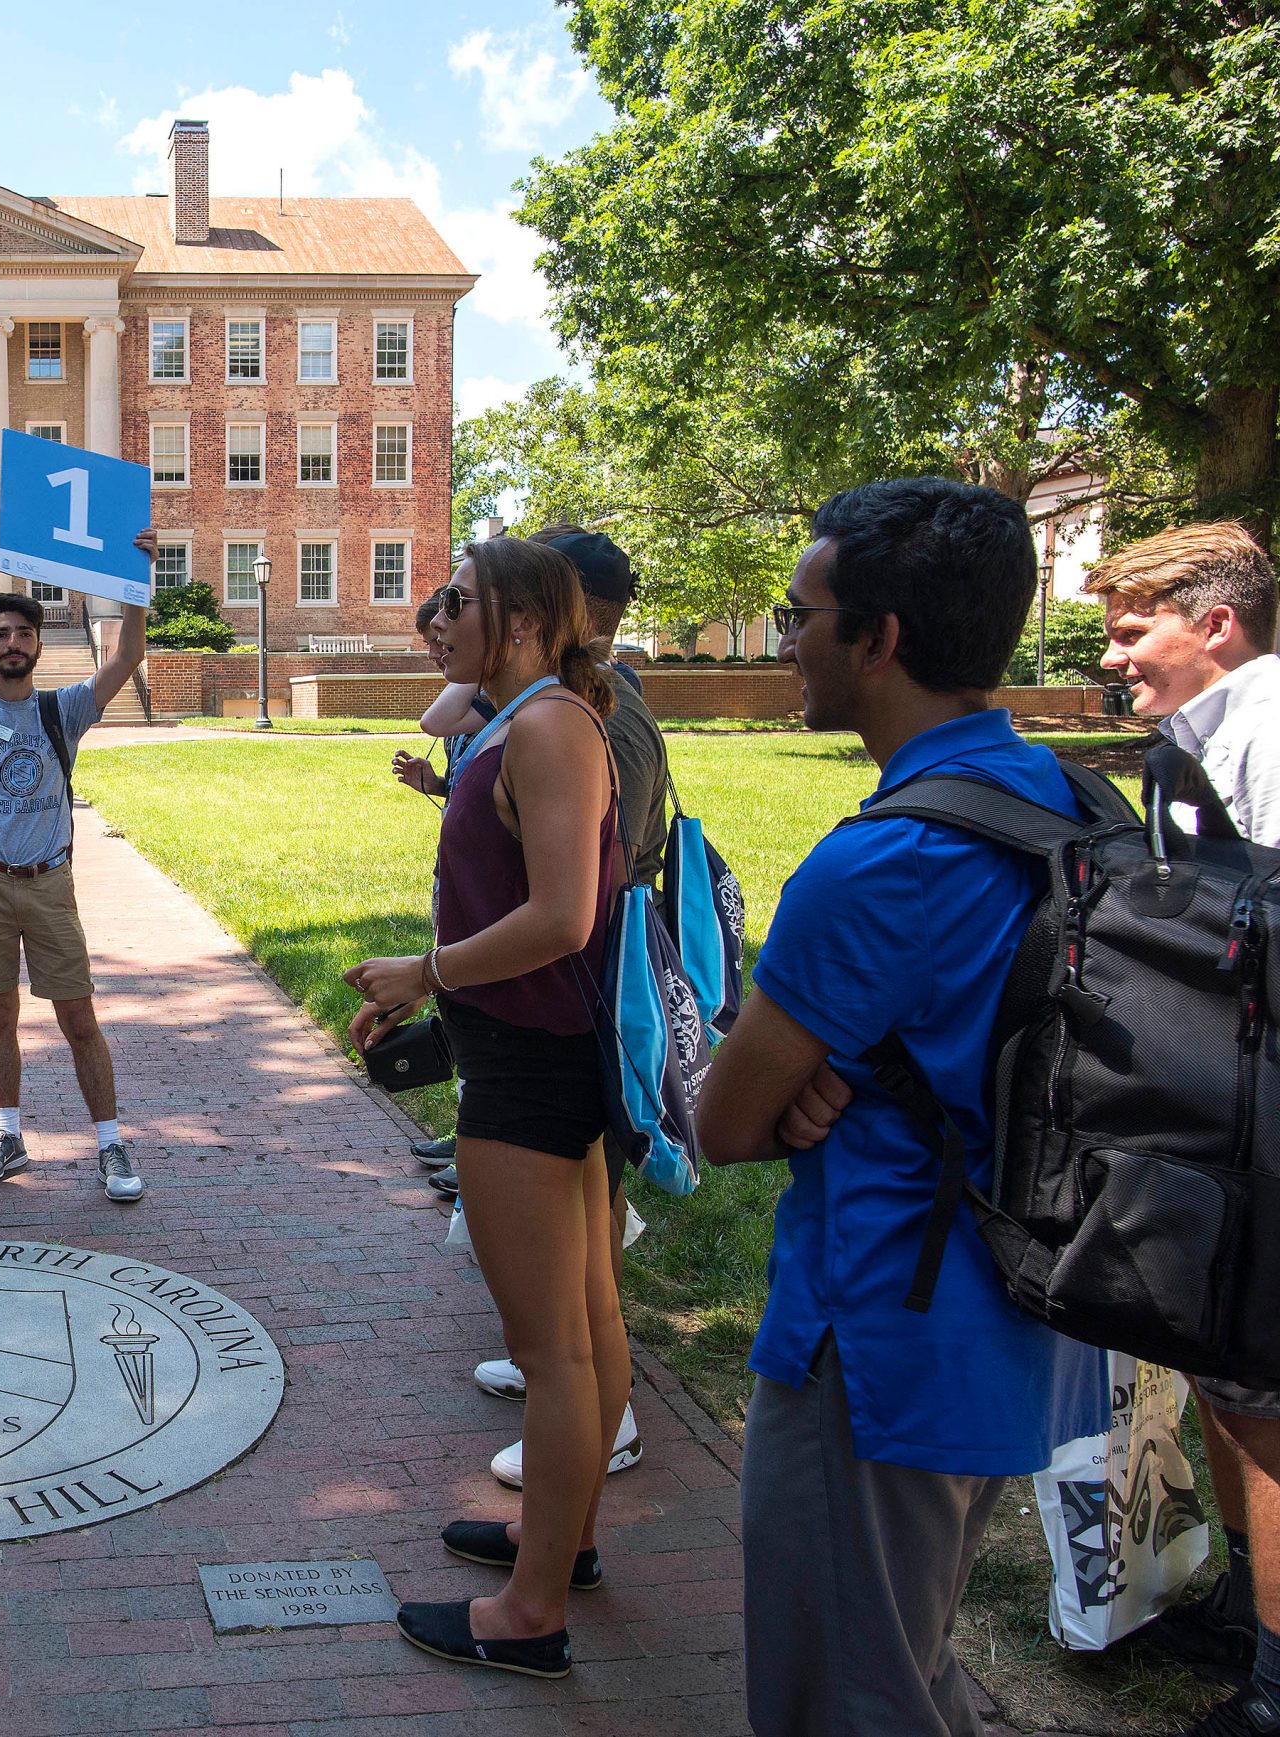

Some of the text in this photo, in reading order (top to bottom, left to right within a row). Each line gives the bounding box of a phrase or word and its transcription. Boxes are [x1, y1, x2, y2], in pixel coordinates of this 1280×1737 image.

[47, 467, 104, 552] 1
[109, 1265, 268, 1373] CAROLINA
[3, 1469, 164, 1526] HILL
[212, 1582, 384, 1602] THE SENIOR CLASS
[228, 1567, 353, 1584] DONATED BY
[281, 1602, 328, 1617] 1989
